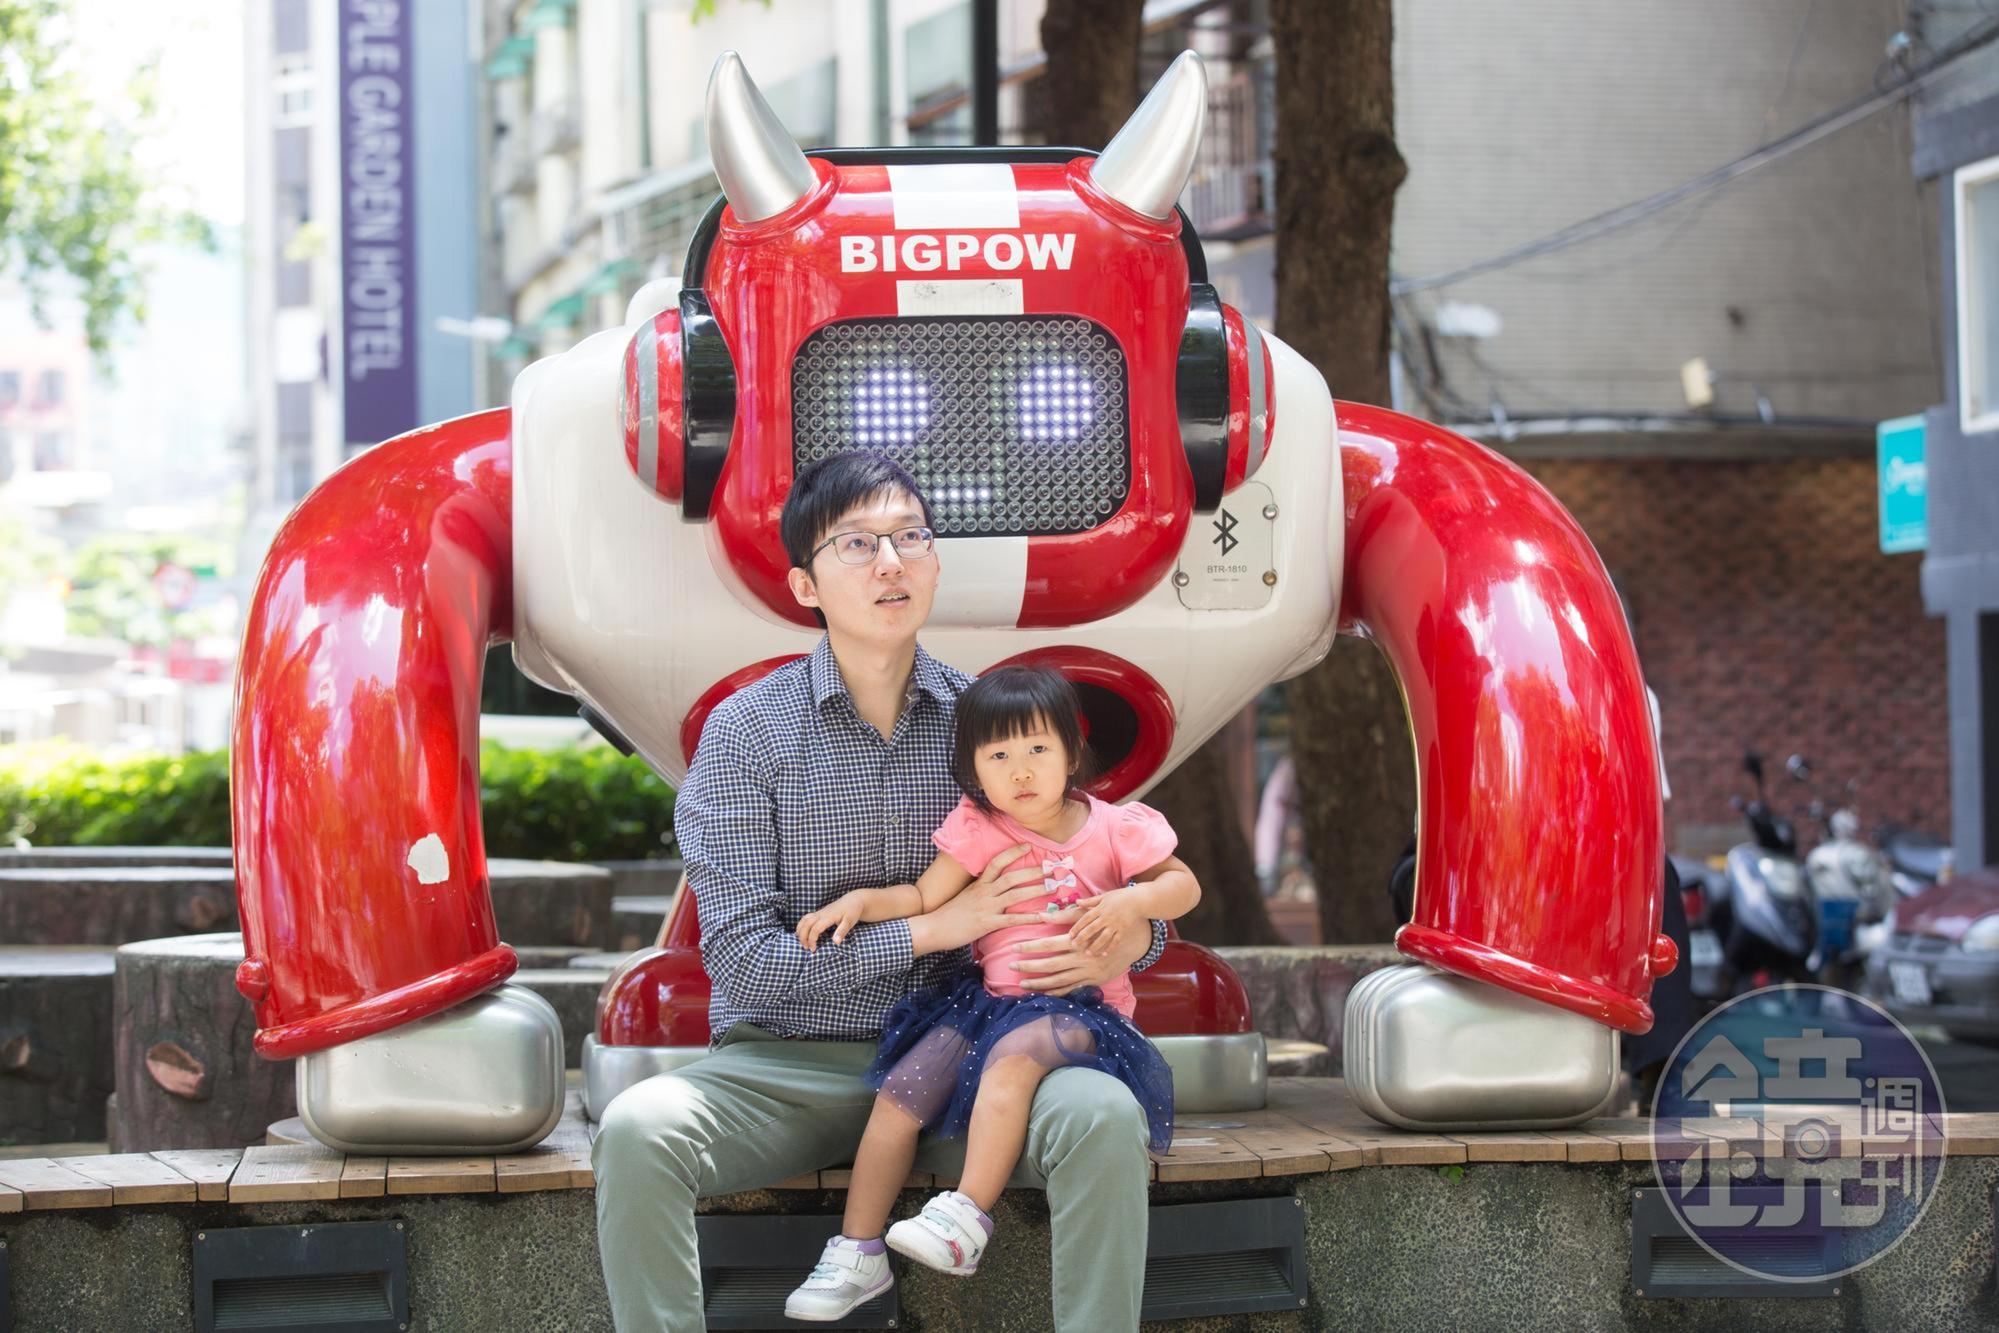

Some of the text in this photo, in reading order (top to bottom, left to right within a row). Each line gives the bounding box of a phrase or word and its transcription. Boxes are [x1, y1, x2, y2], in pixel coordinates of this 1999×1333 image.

[349, 0, 402, 380] PLE GARDEN HOTEL
[840, 234, 1076, 272] BIGPOW
[1207, 565, 1247, 574] BTR-1810
